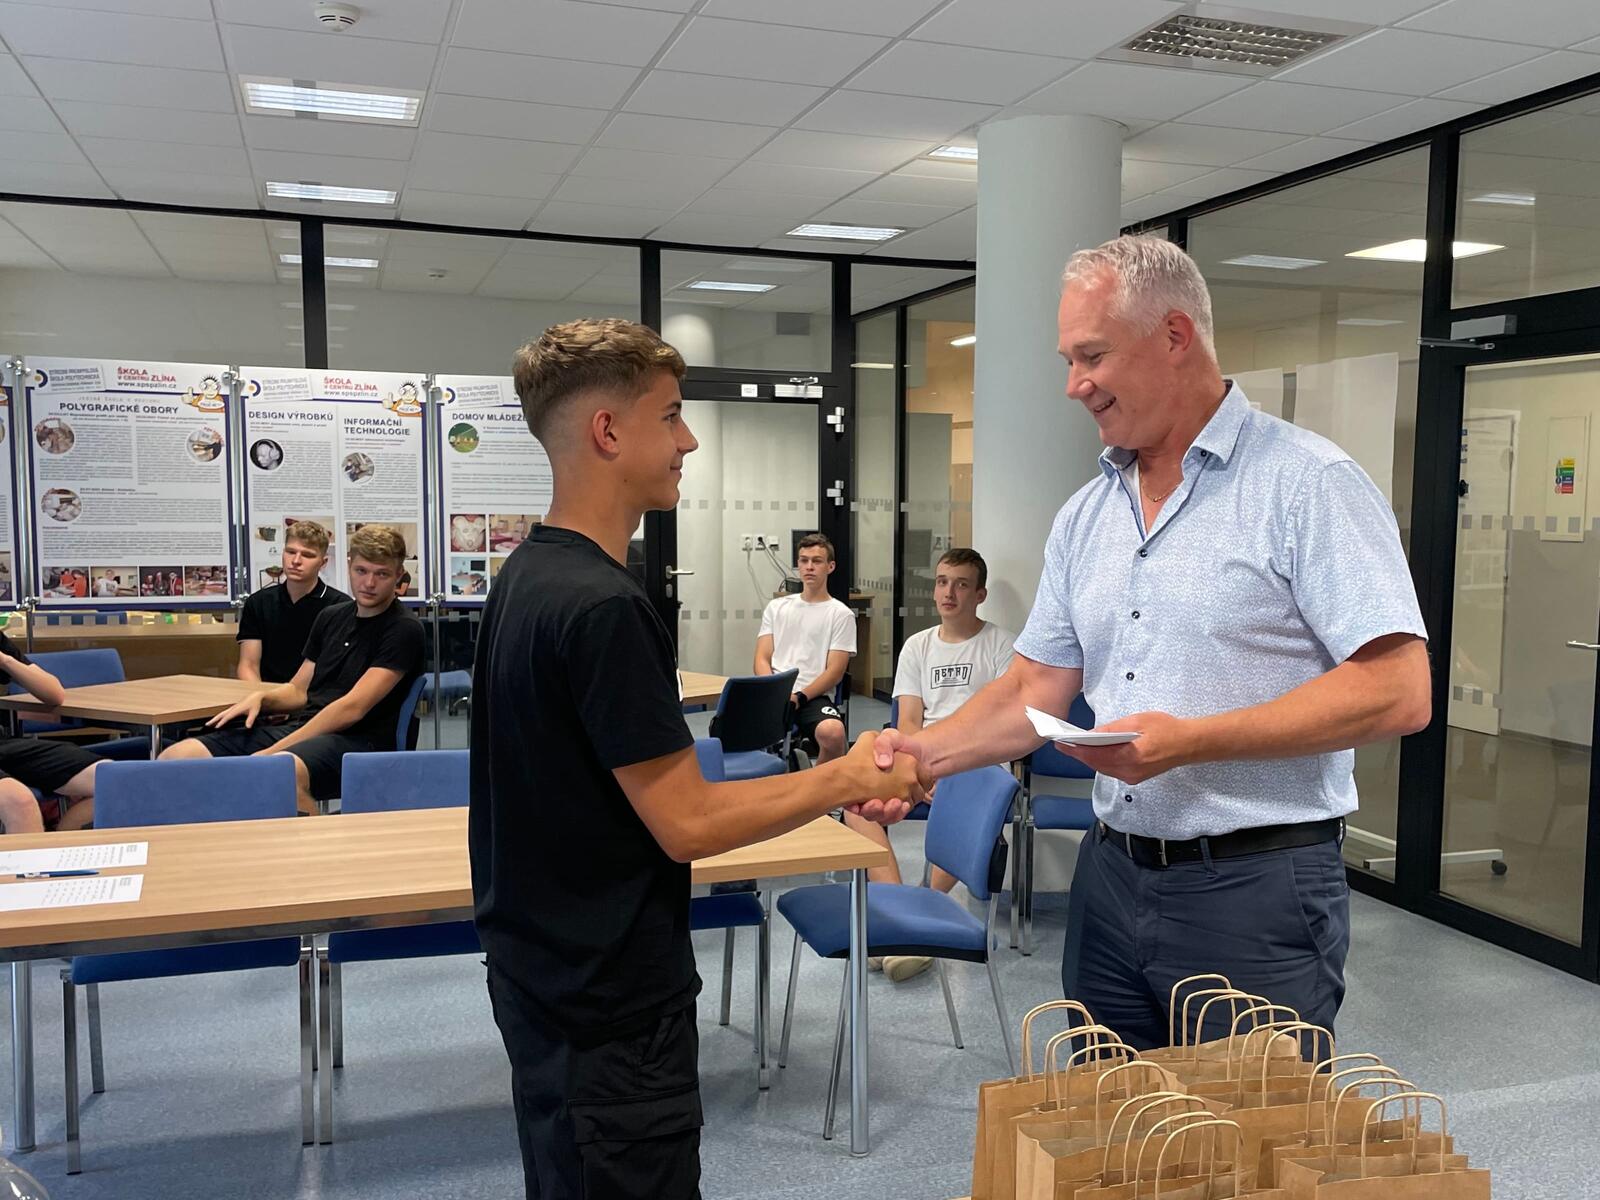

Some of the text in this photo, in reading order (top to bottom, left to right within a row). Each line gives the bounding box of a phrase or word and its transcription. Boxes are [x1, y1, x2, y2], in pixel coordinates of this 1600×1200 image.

[117, 366, 148, 375] ŠKOLA
[151, 373, 176, 382] ZLÍNA
[324, 375, 352, 385] ŠKOLA
[354, 383, 378, 391] ZLÍNA
[59, 402, 178, 414] POLYGRAFICKÉ OBORY
[248, 411, 334, 421] DESIGN VÝROBKŮ
[452, 412, 485, 421] DOMOV
[344, 417, 403, 427] INFORMAČNÍ
[344, 426, 411, 436] TECHNOLOGIE
